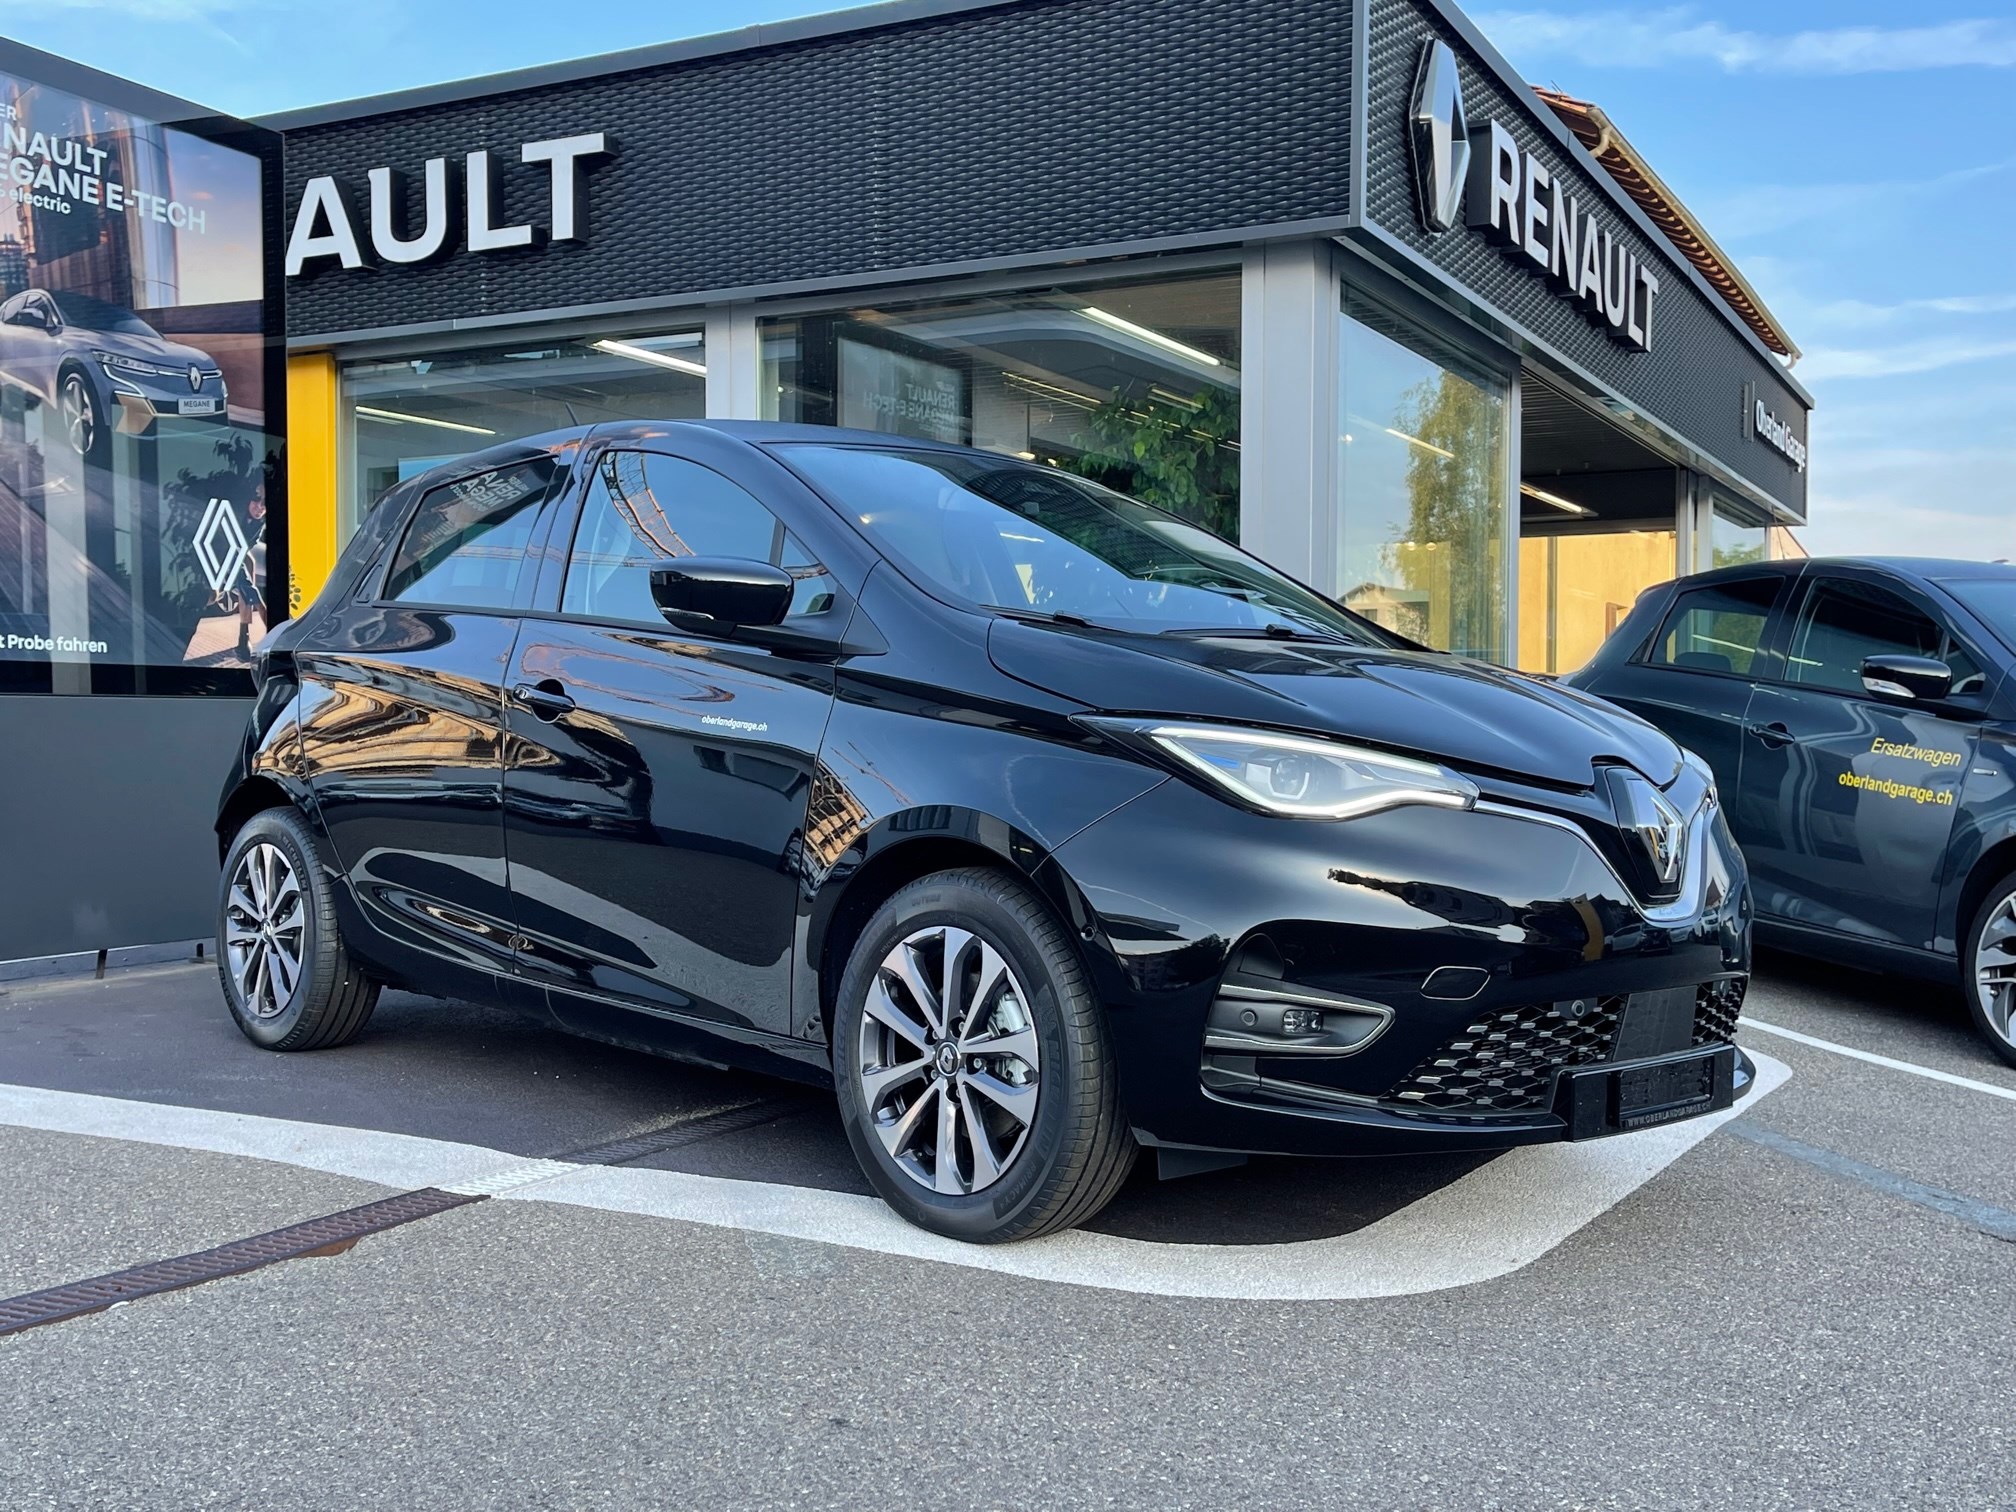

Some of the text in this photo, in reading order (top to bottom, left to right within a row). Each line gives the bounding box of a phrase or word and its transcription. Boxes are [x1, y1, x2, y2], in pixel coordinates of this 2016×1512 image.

[3, 122, 108, 176] NAULT
[9, 187, 72, 215] electric
[106, 182, 206, 234] E-TECH
[285, 132, 605, 276] AULT
[1490, 118, 1659, 353] RENAULT
[183, 400, 211, 408] MEGANE
[1756, 399, 1806, 473] Oberland Garage
[7, 634, 54, 651] Probe
[56, 636, 108, 654] fahren
[701, 714, 768, 732] oberlandgarage.ch
[1870, 737, 1962, 768] Ersatzwagen
[1838, 771, 1953, 806] oberlandgarage.ch
